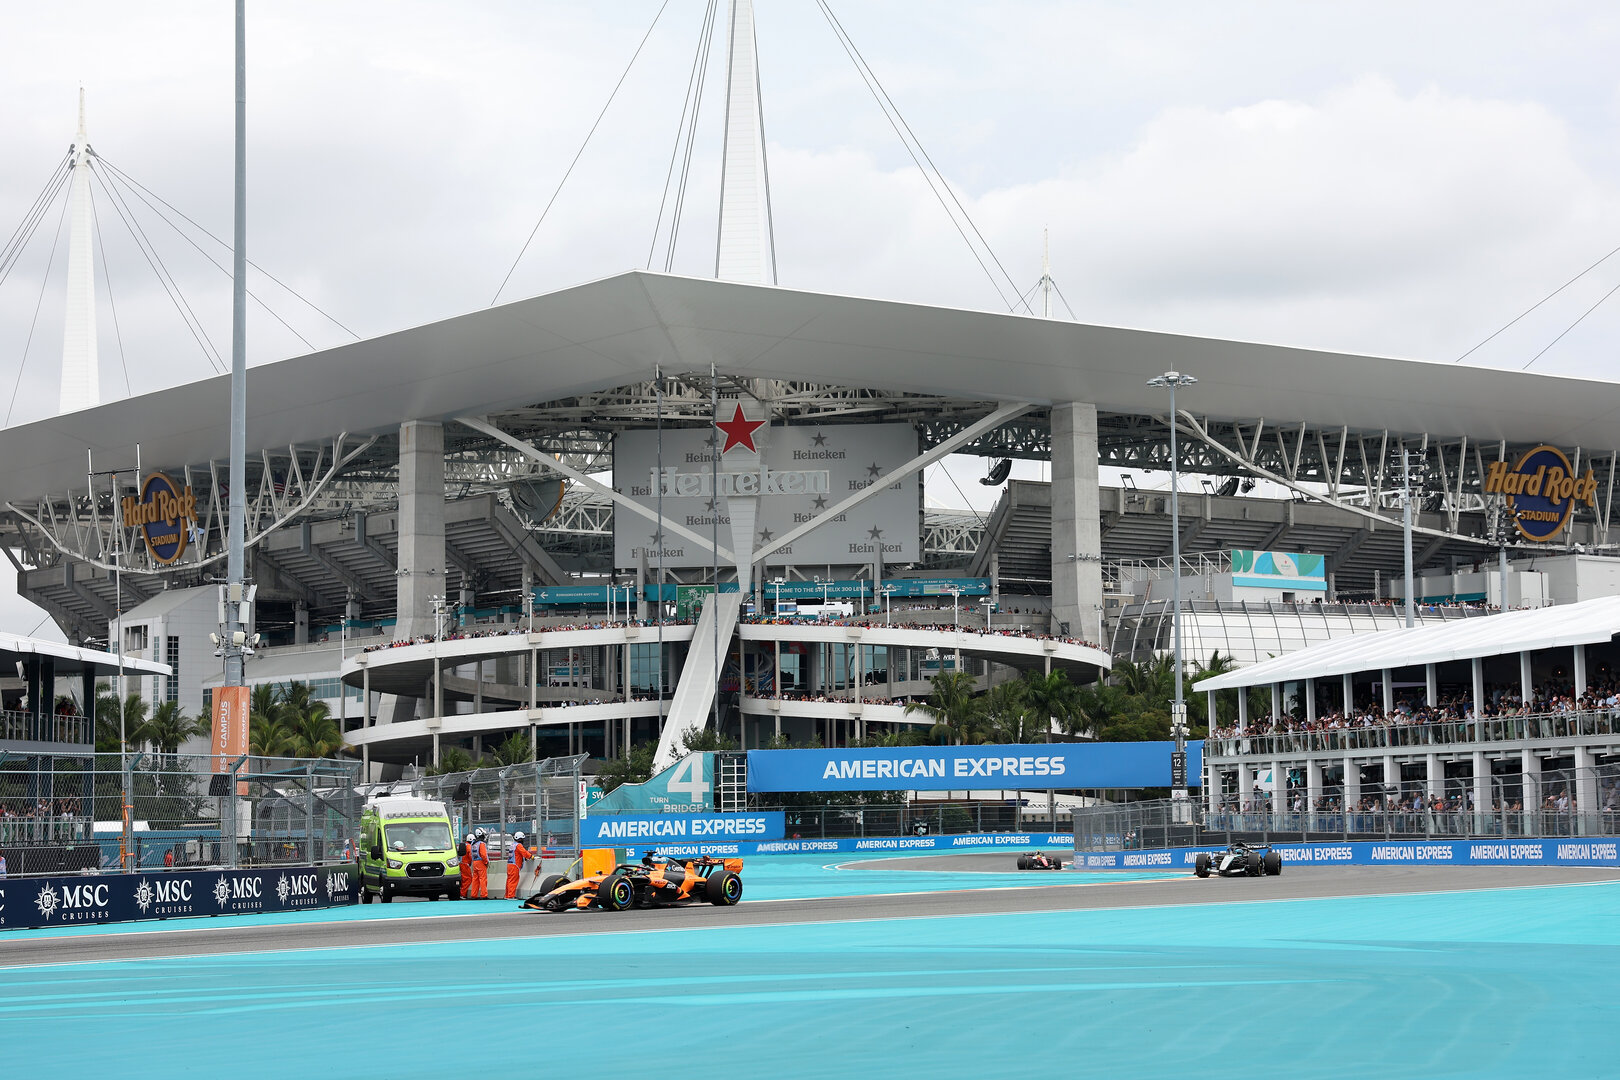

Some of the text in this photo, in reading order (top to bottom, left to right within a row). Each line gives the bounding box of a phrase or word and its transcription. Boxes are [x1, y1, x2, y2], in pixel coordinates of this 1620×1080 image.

[685, 453, 723, 463] Heinek
[792, 450, 846, 460] Heineken
[650, 465, 826, 497] Heineken
[1486, 461, 1598, 507] Hard Rock
[122, 486, 198, 527] Hard Rock
[686, 515, 730, 526] Heineke
[1520, 510, 1560, 522] STADIUM
[151, 534, 179, 546] STADIUM
[631, 548, 684, 558] Hineken
[848, 543, 902, 553] Heinken
[220, 701, 228, 748] CAMPUS
[823, 756, 1066, 779] AMERICAN EXPRESS
[1173, 758, 1181, 767] 12
[667, 753, 709, 803] 4
[592, 791, 605, 799] SW
[663, 803, 704, 813] BRIDGE
[598, 818, 766, 838] AMERICAN EXPRESS
[757, 841, 838, 852] AMERICAN EXPRESS
[856, 839, 935, 849] AMERICAN EXPRESS
[953, 835, 1030, 846] AMERICAN EXPRESS
[654, 845, 738, 856] AMERICAN EXPRESS
[1314, 847, 1352, 860] EXPRESS
[1371, 845, 1453, 860] AMERICAN EXPRESS
[1470, 844, 1543, 859] AMERICAN EXPRESS
[1557, 843, 1617, 860] AMERICAN EXPRESS
[1123, 853, 1172, 866] AMERICAN EXPRESS
[232, 877, 262, 899] MSC
[290, 874, 317, 896] MSC
[333, 872, 349, 892] MSC
[62, 884, 109, 909] MSC
[155, 879, 192, 902] MSC
[232, 901, 262, 909] CRUISES
[291, 898, 318, 906] CRUISES
[62, 911, 109, 920] CRUISES
[155, 905, 193, 914] CRUISES
